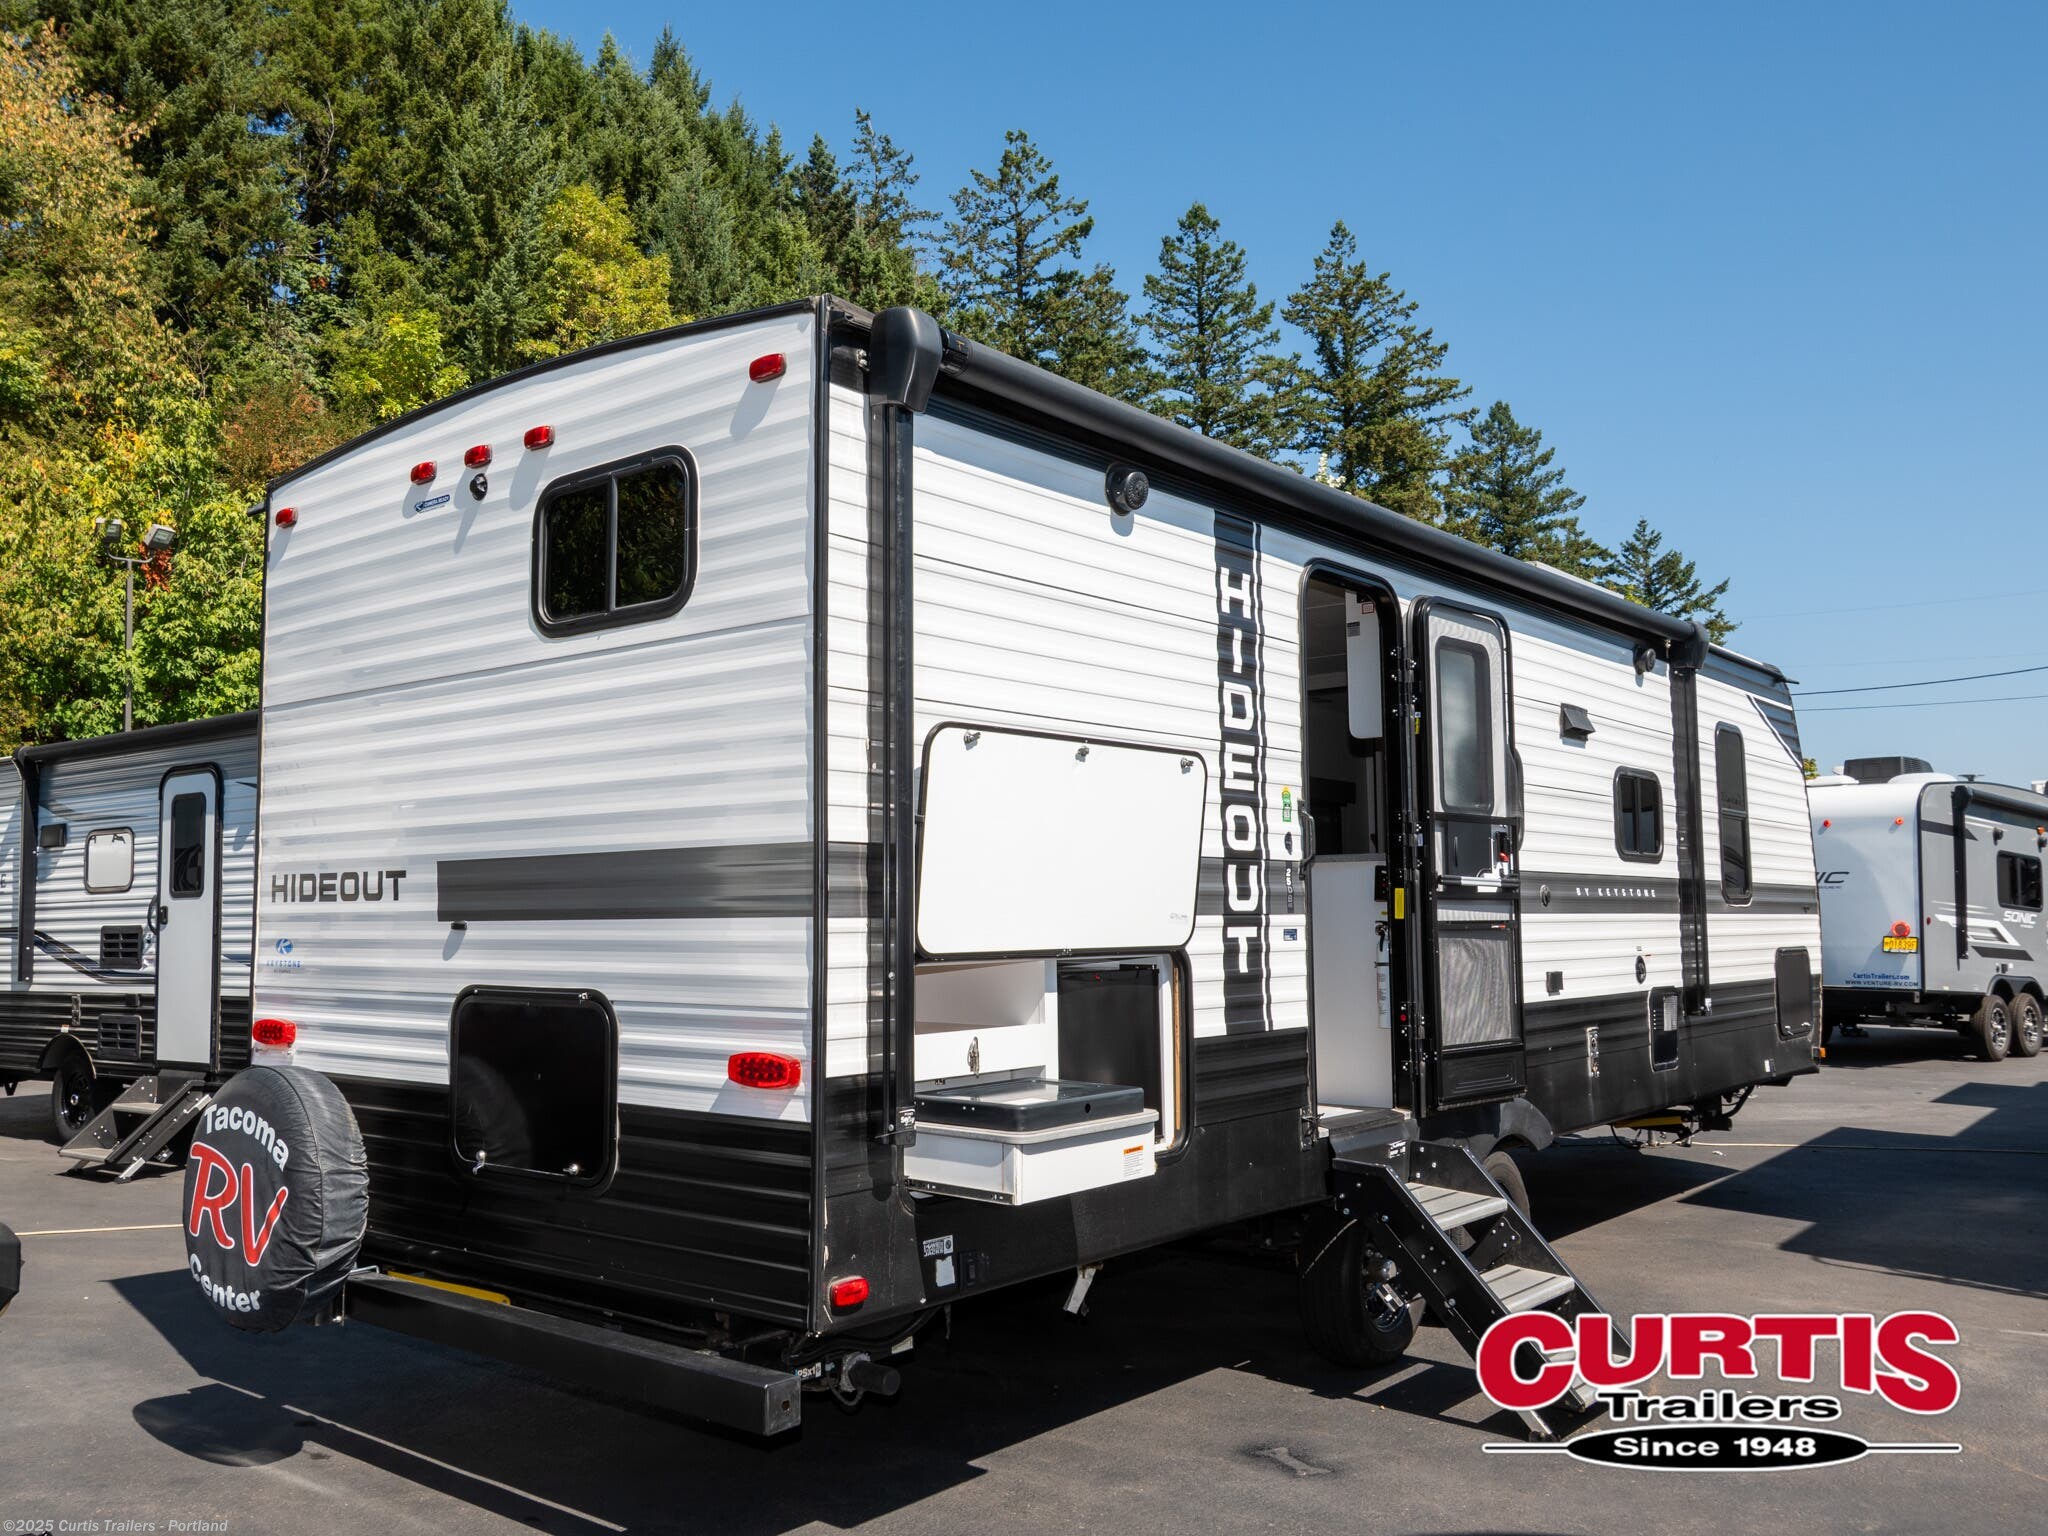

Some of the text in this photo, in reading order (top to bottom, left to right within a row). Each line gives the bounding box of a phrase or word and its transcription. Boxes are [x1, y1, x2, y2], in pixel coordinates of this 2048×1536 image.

[1220, 567, 1259, 973] HIDEOUT
[271, 870, 406, 903] HIDEOUT
[1576, 887, 1656, 898] BY KEYSTONE
[2003, 911, 2038, 925] SONIC
[204, 1103, 290, 1172] Tacoma
[188, 1141, 290, 1268] RV
[189, 1253, 261, 1314] Center
